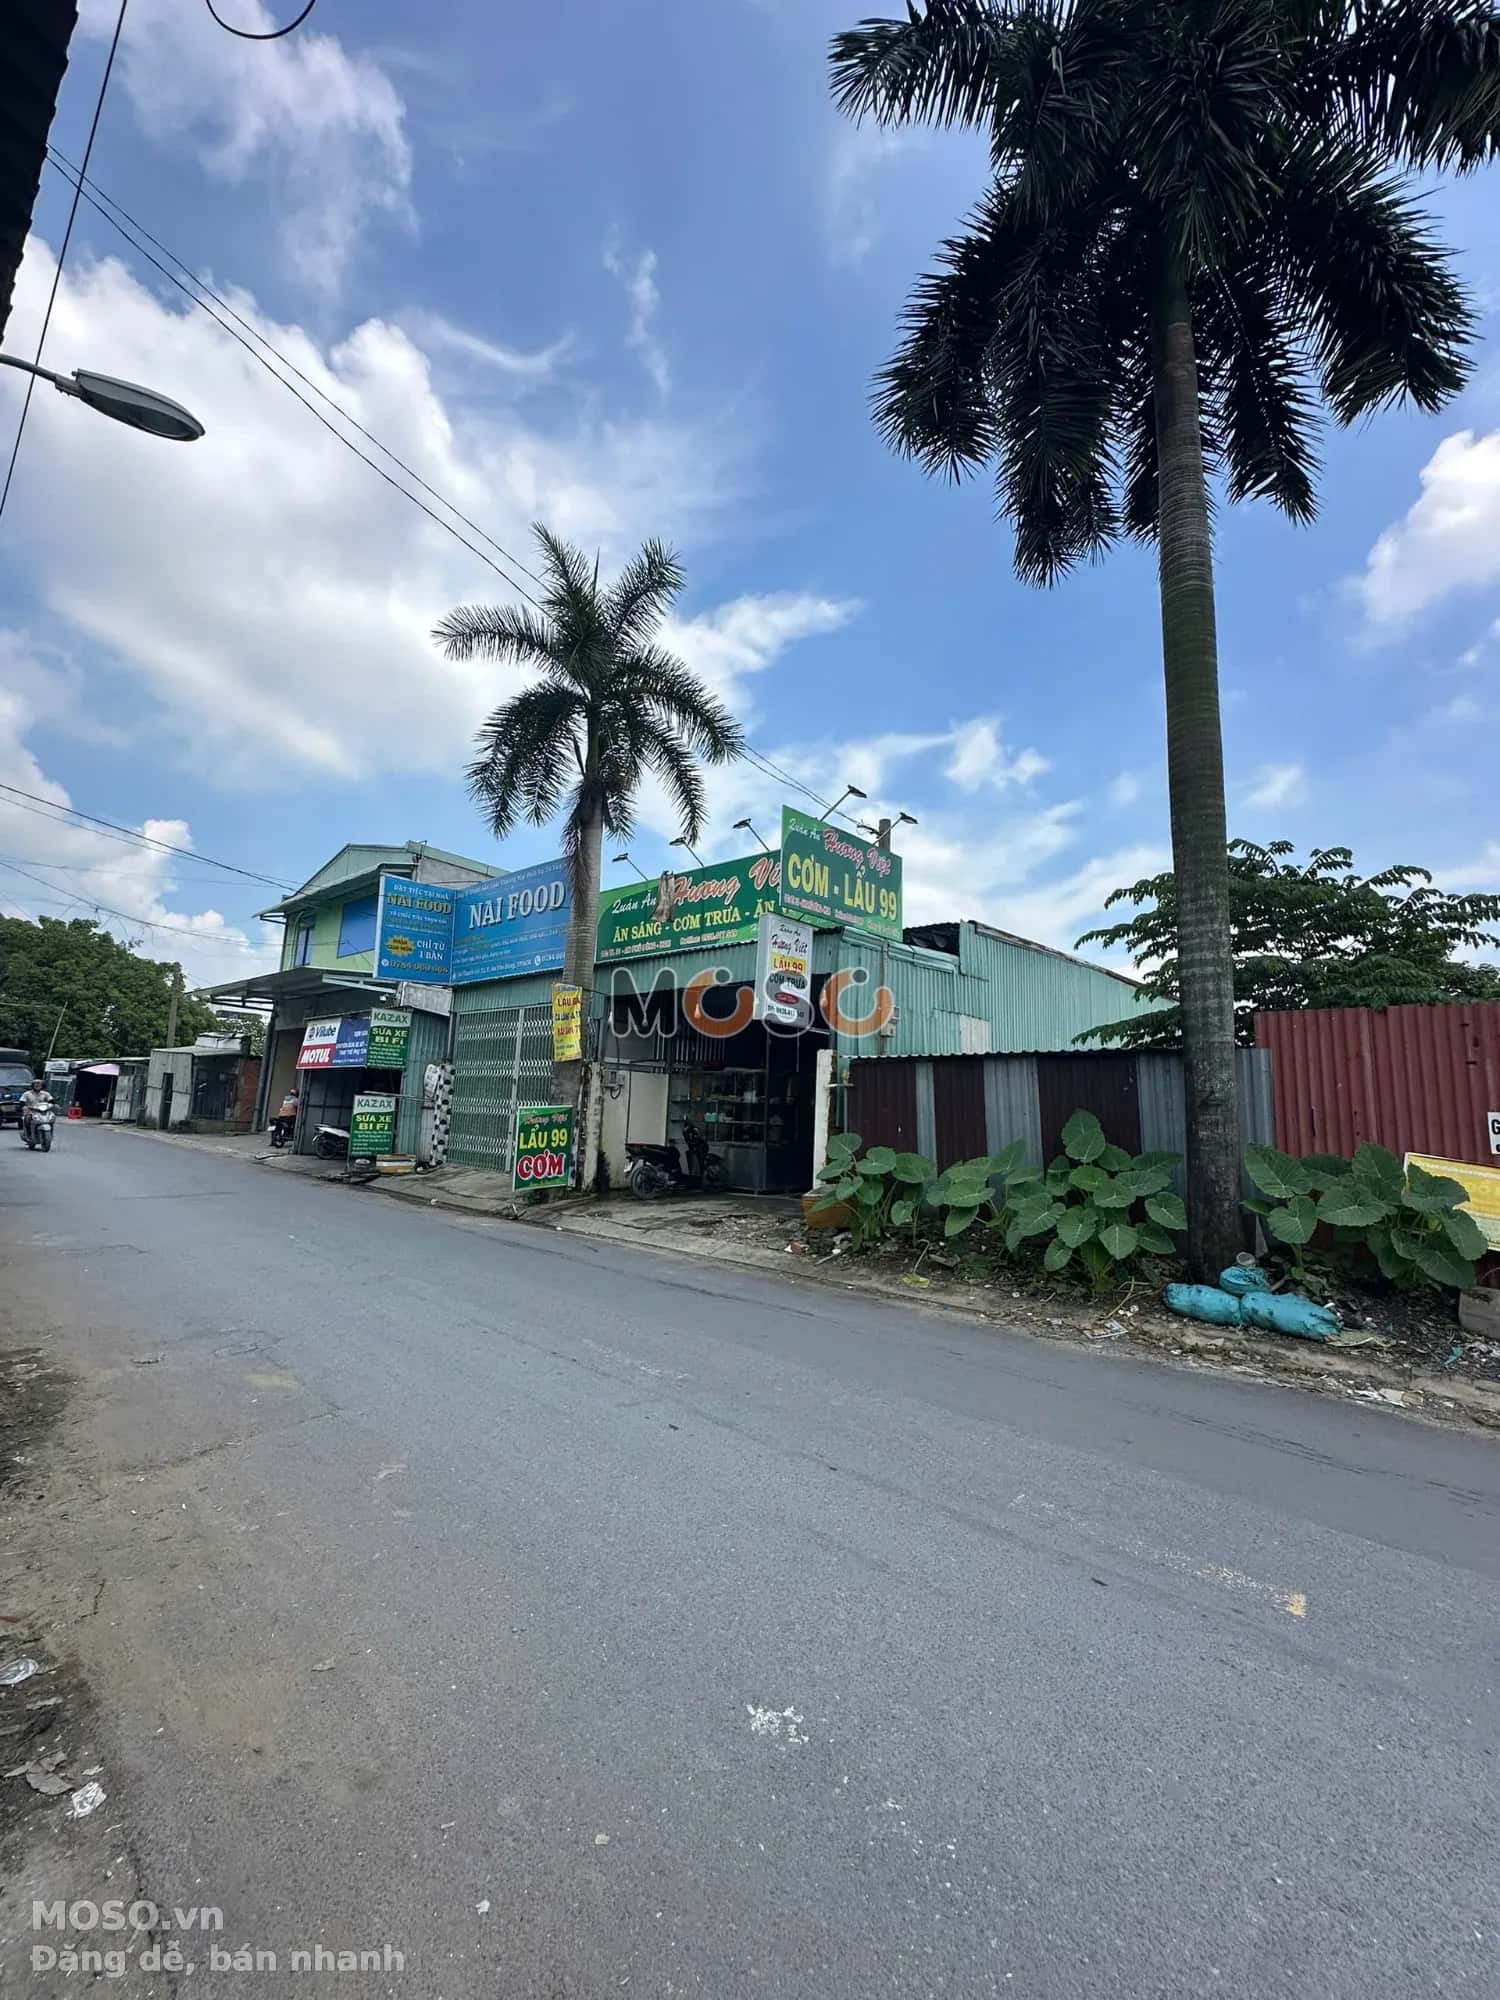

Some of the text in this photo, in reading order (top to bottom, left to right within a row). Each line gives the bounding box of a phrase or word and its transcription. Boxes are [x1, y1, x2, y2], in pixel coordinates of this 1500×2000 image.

[507, 881, 565, 920] FOOD
[612, 900, 638, 914] Quán
[673, 876, 741, 905] Hương
[788, 853, 829, 898] CƠM
[844, 865, 875, 913] LẨU
[880, 888, 897, 920] 99
[415, 899, 452, 914] FOOD
[613, 924, 629, 943] ĂN
[631, 921, 662, 941] SÁNG
[673, 913, 700, 932] CƠM
[704, 905, 741, 927] TRƯA
[374, 1012, 408, 1024] KAZAX
[300, 1048, 331, 1064] MOTUL
[357, 1098, 392, 1108] KAZAX
[520, 1124, 568, 1149] LẨU 99
[517, 1149, 566, 1180] CƠM
